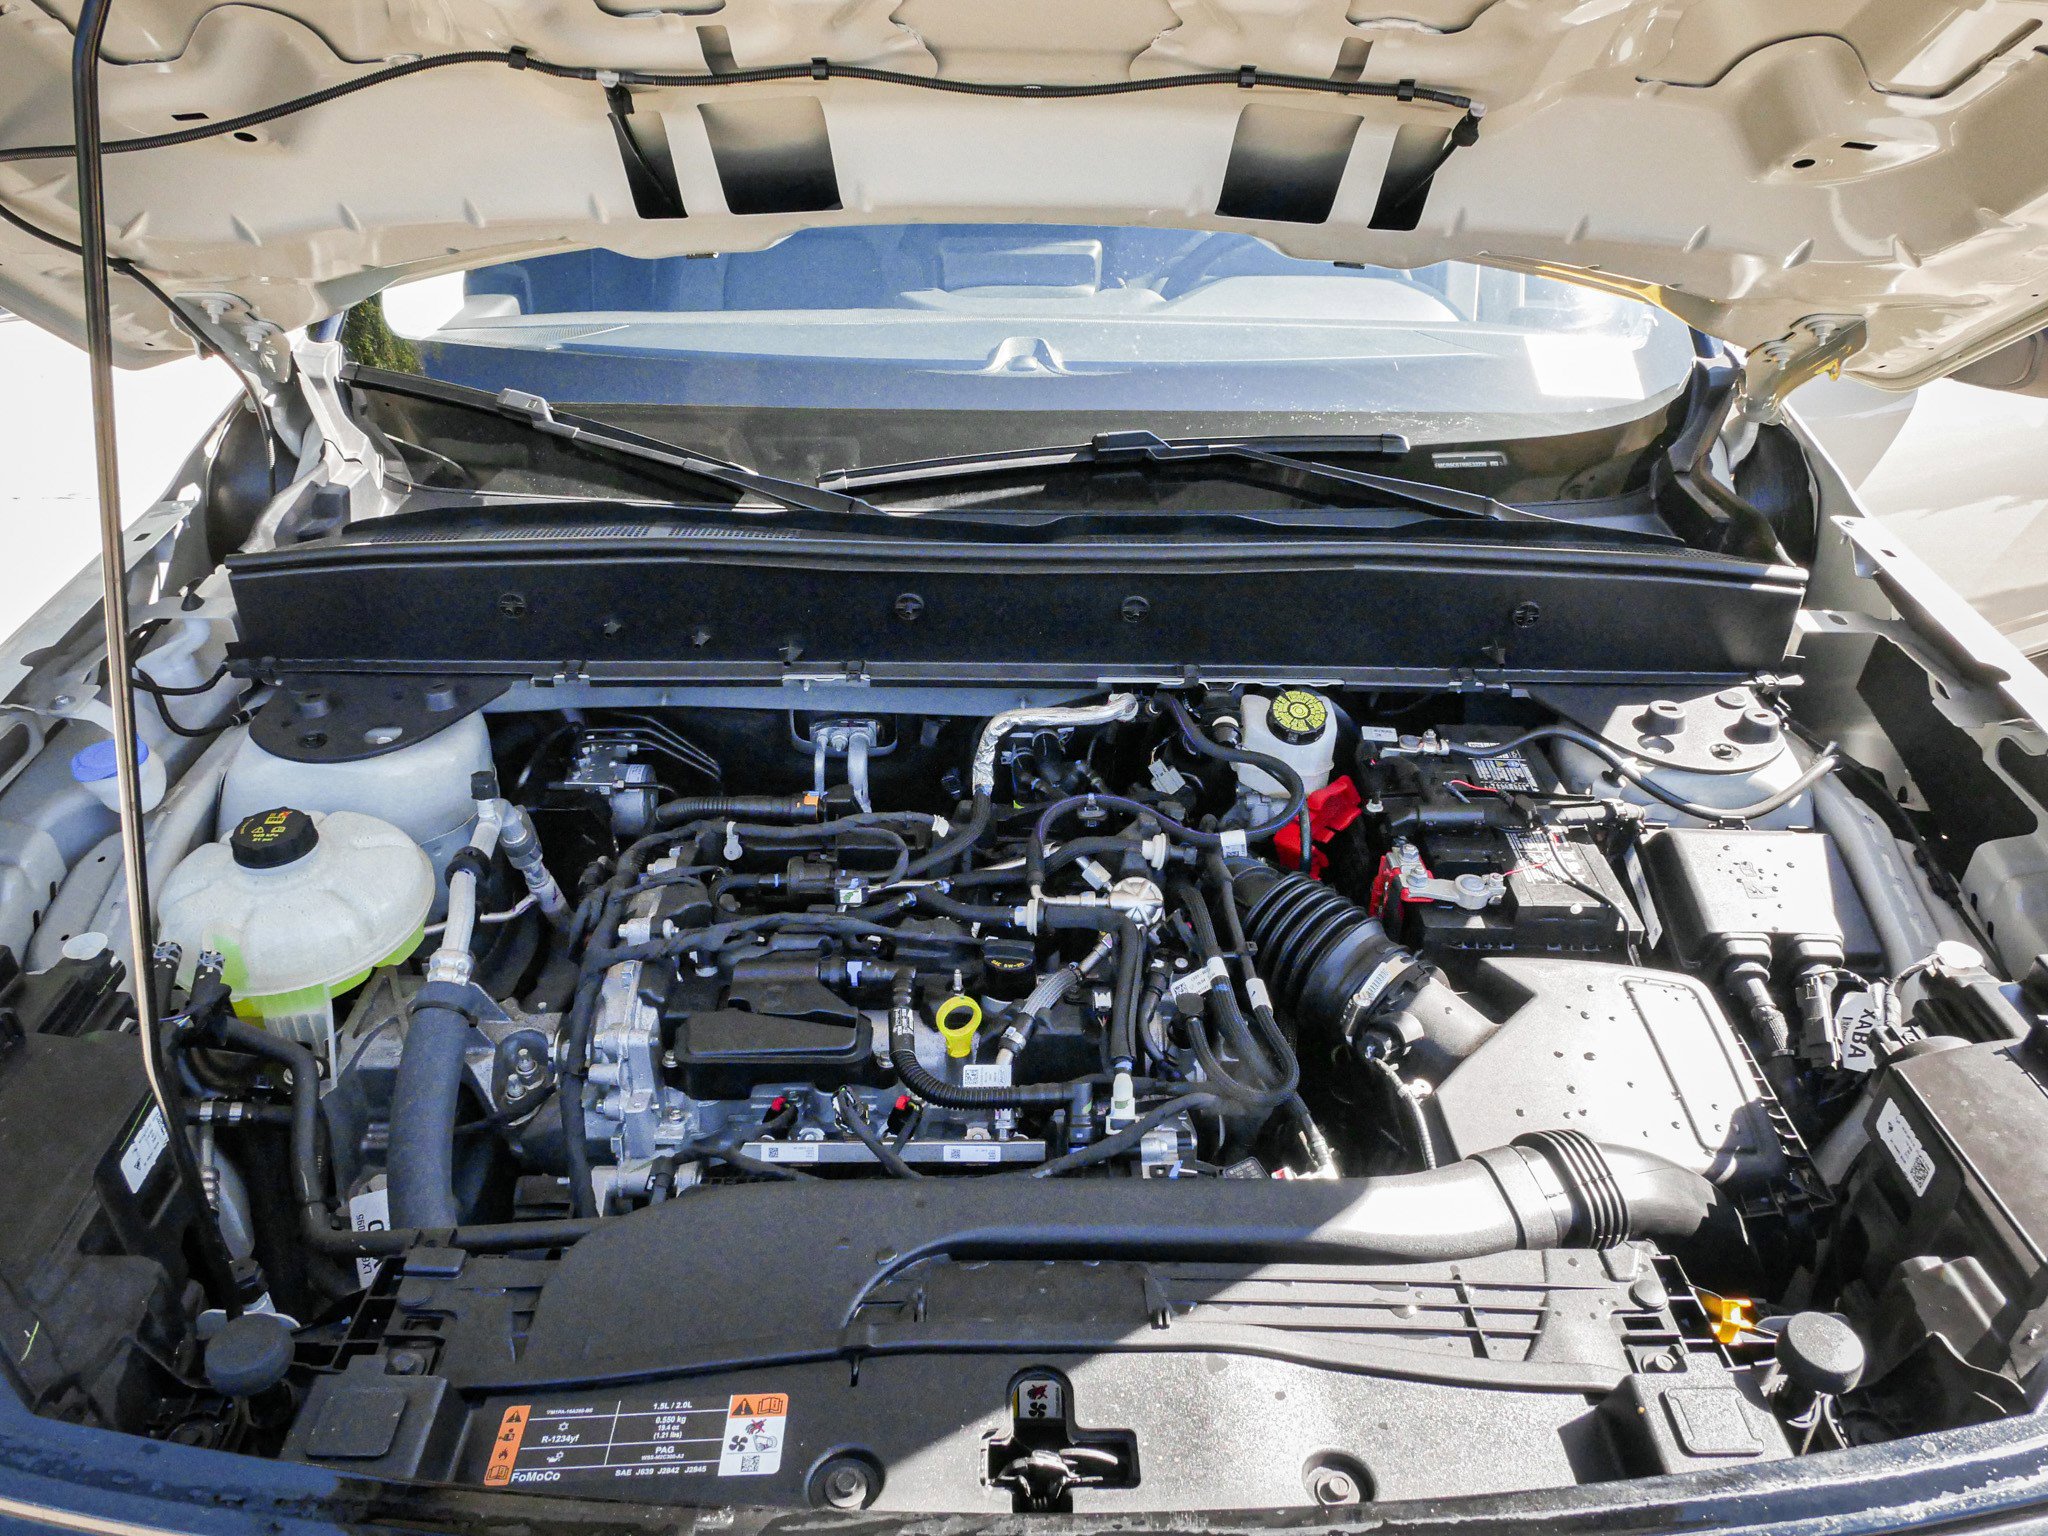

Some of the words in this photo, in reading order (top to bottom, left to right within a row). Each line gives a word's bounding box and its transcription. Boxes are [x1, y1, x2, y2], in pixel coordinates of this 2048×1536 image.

[1847, 1008, 1876, 1059] XABA
[653, 1402, 670, 1410] 1.5L
[675, 1401, 693, 1409] 2.0L
[655, 1416, 676, 1424] 0.550
[676, 1415, 687, 1424] kg
[541, 1434, 580, 1444] R-1234yf
[655, 1445, 675, 1454] PAG
[510, 1471, 561, 1482] FoMoCo
[615, 1469, 632, 1477] SAE
[635, 1467, 654, 1476] J639
[657, 1466, 680, 1475] J2842
